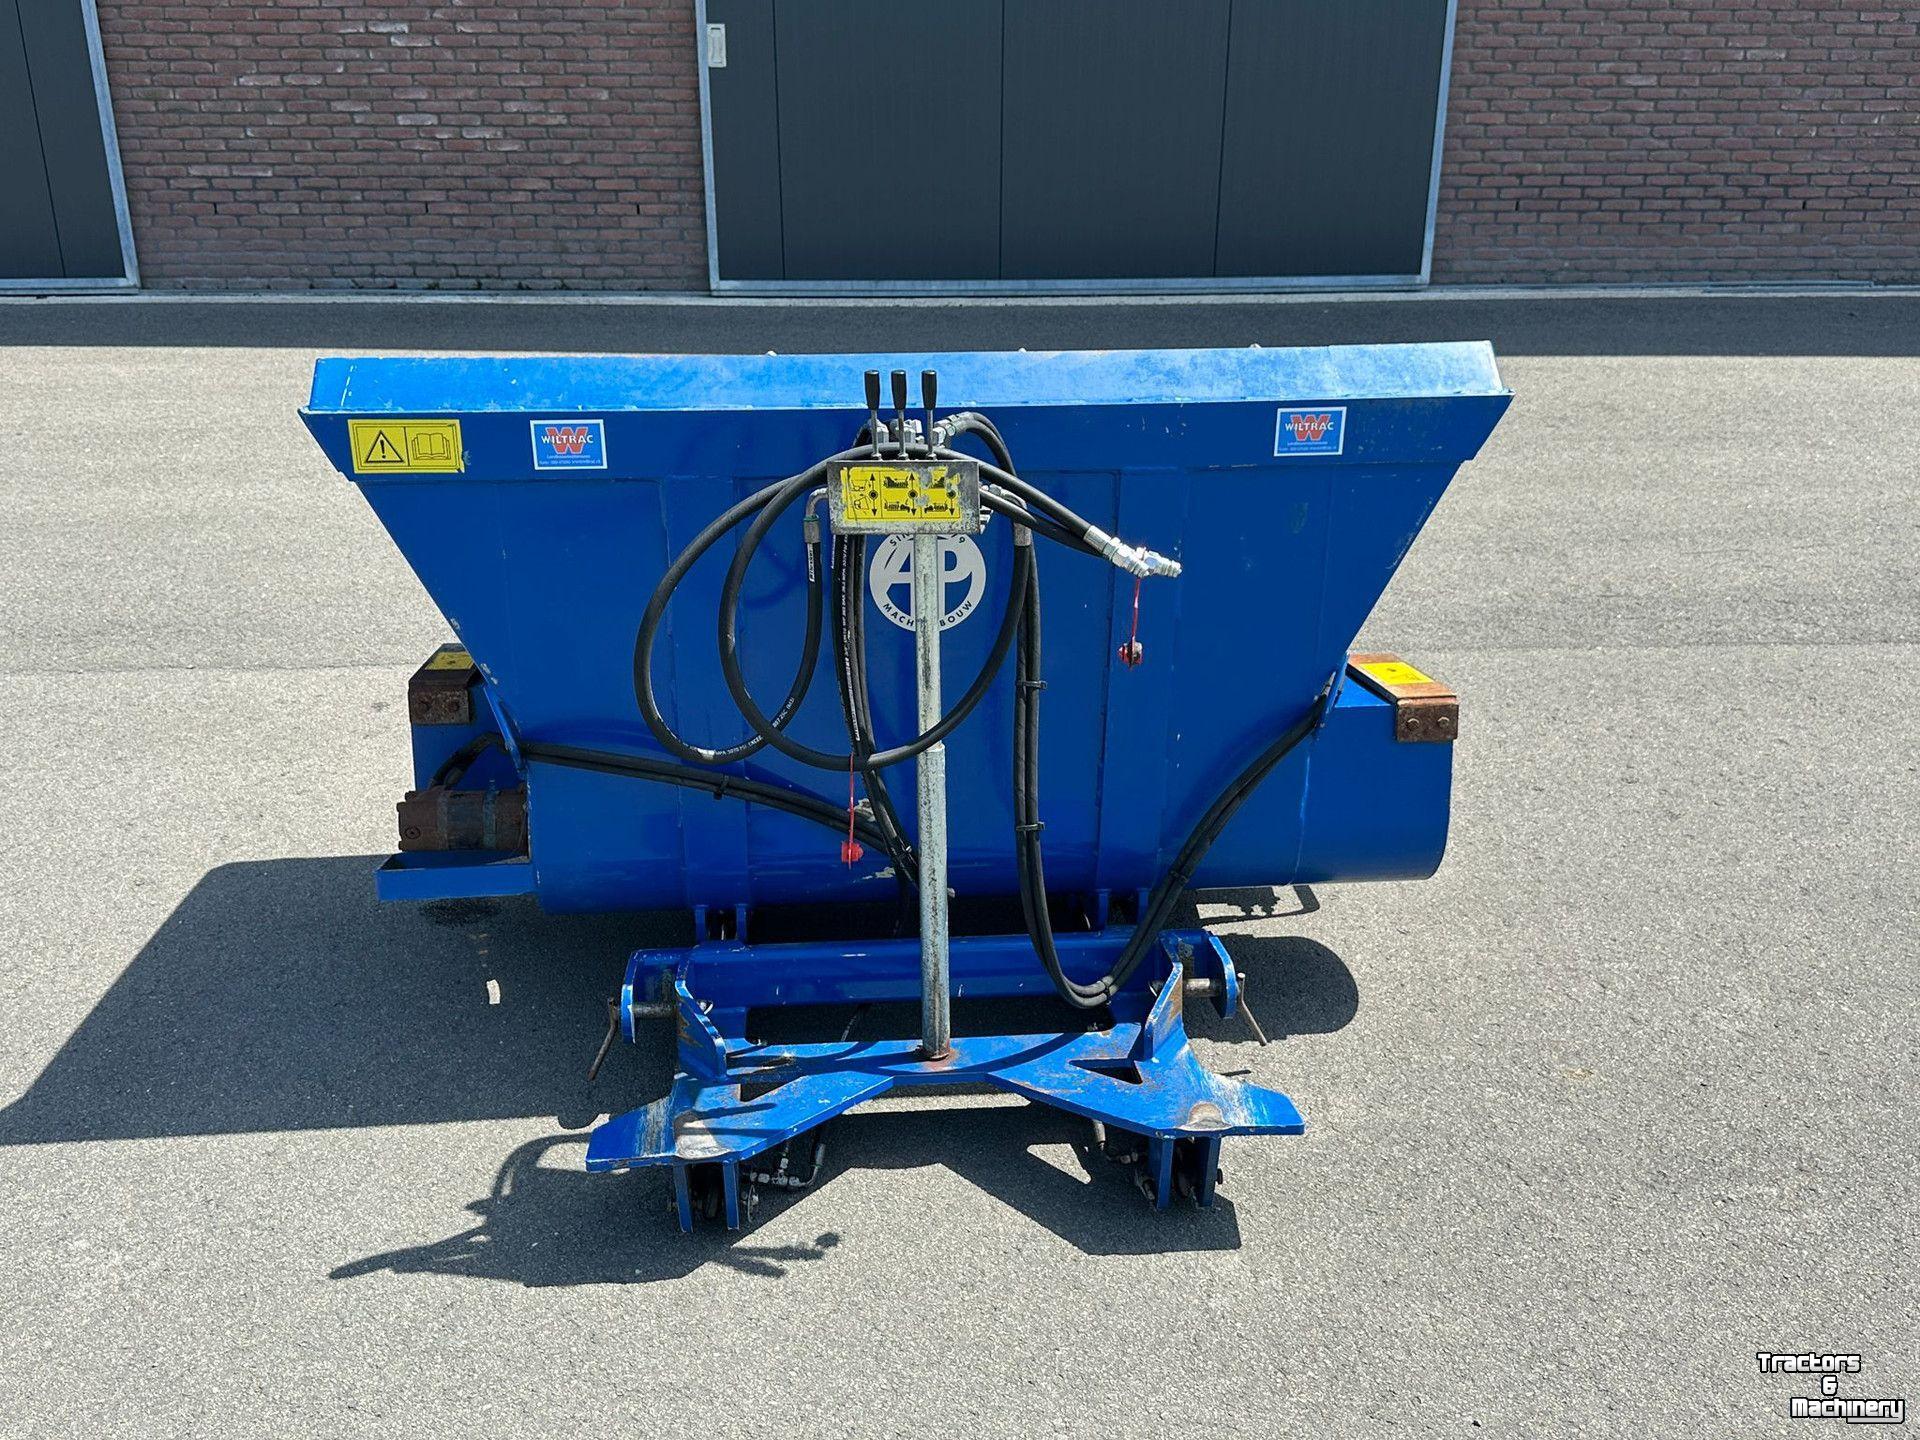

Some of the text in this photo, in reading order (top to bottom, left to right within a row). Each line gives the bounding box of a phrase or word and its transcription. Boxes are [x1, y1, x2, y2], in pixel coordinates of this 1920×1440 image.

[1284, 421, 1335, 431] WILTRAC
[541, 434, 594, 444] WILTRAC
[882, 600, 973, 628] MACHBOUW
